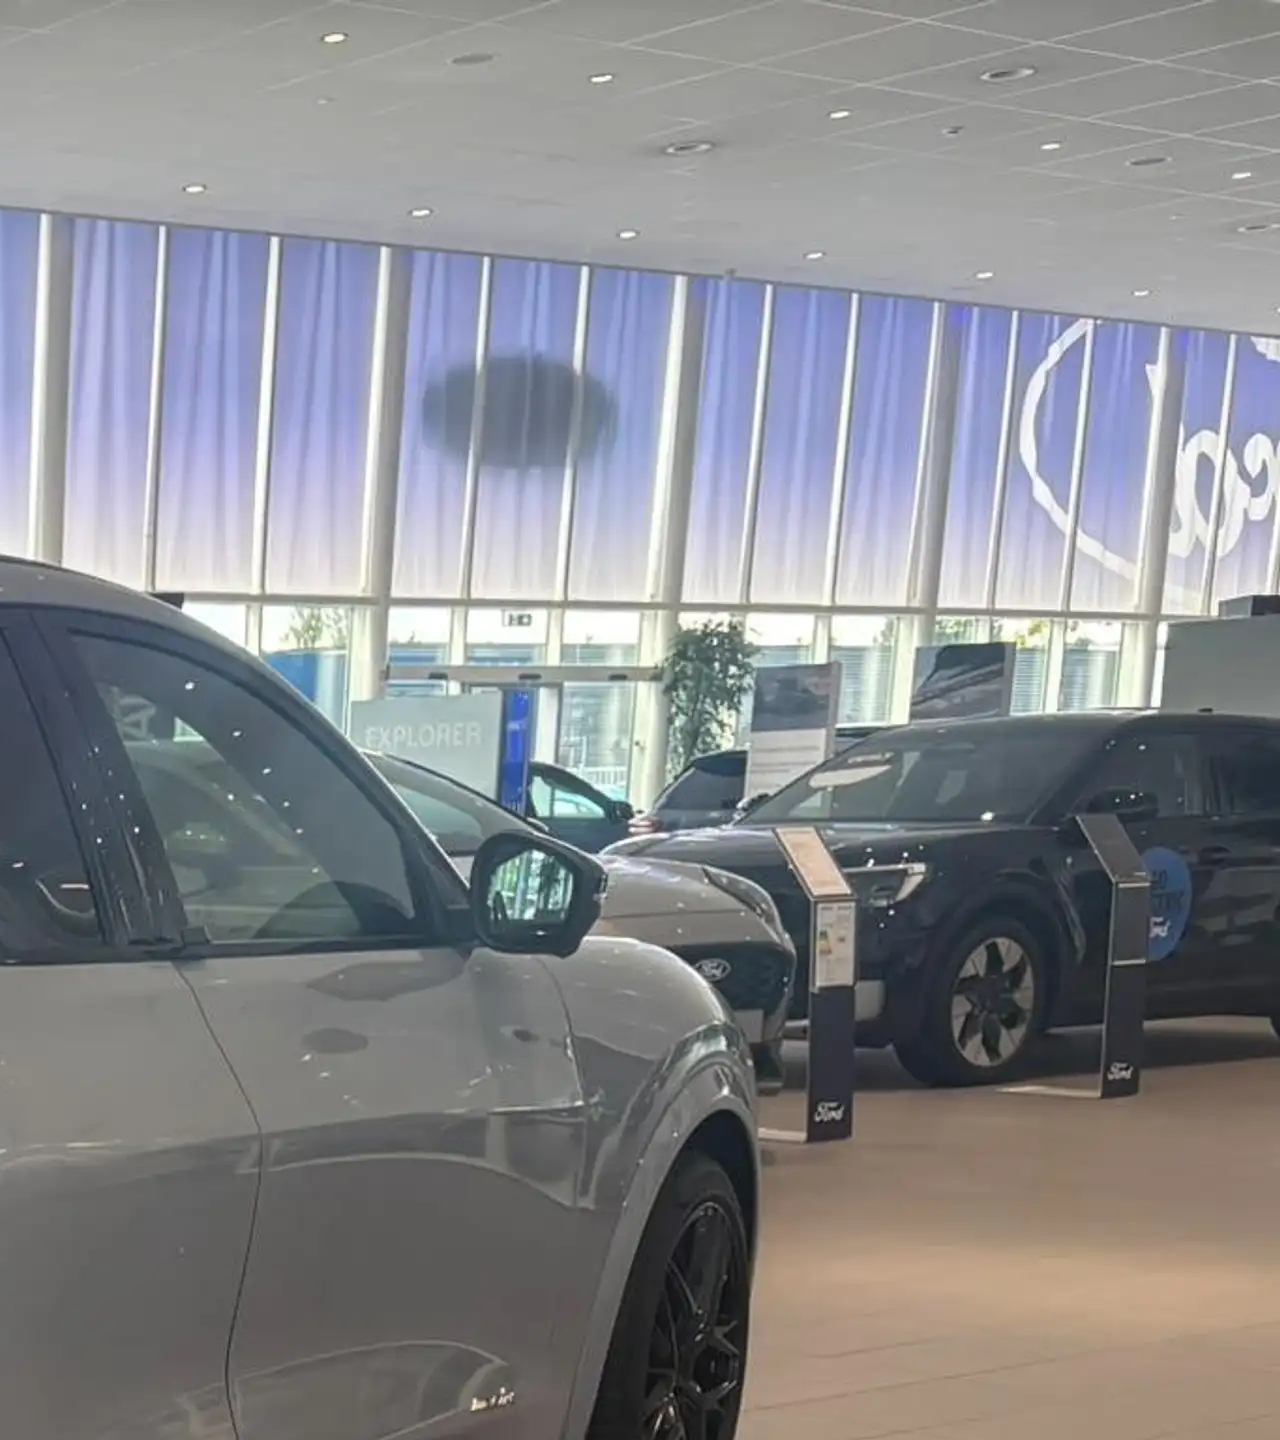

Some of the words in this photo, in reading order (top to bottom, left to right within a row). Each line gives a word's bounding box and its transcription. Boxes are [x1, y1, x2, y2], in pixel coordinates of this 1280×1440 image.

[365, 721, 482, 749] EXPLORER
[1107, 1061, 1134, 1081] Ford
[815, 1101, 844, 1122] Ford
